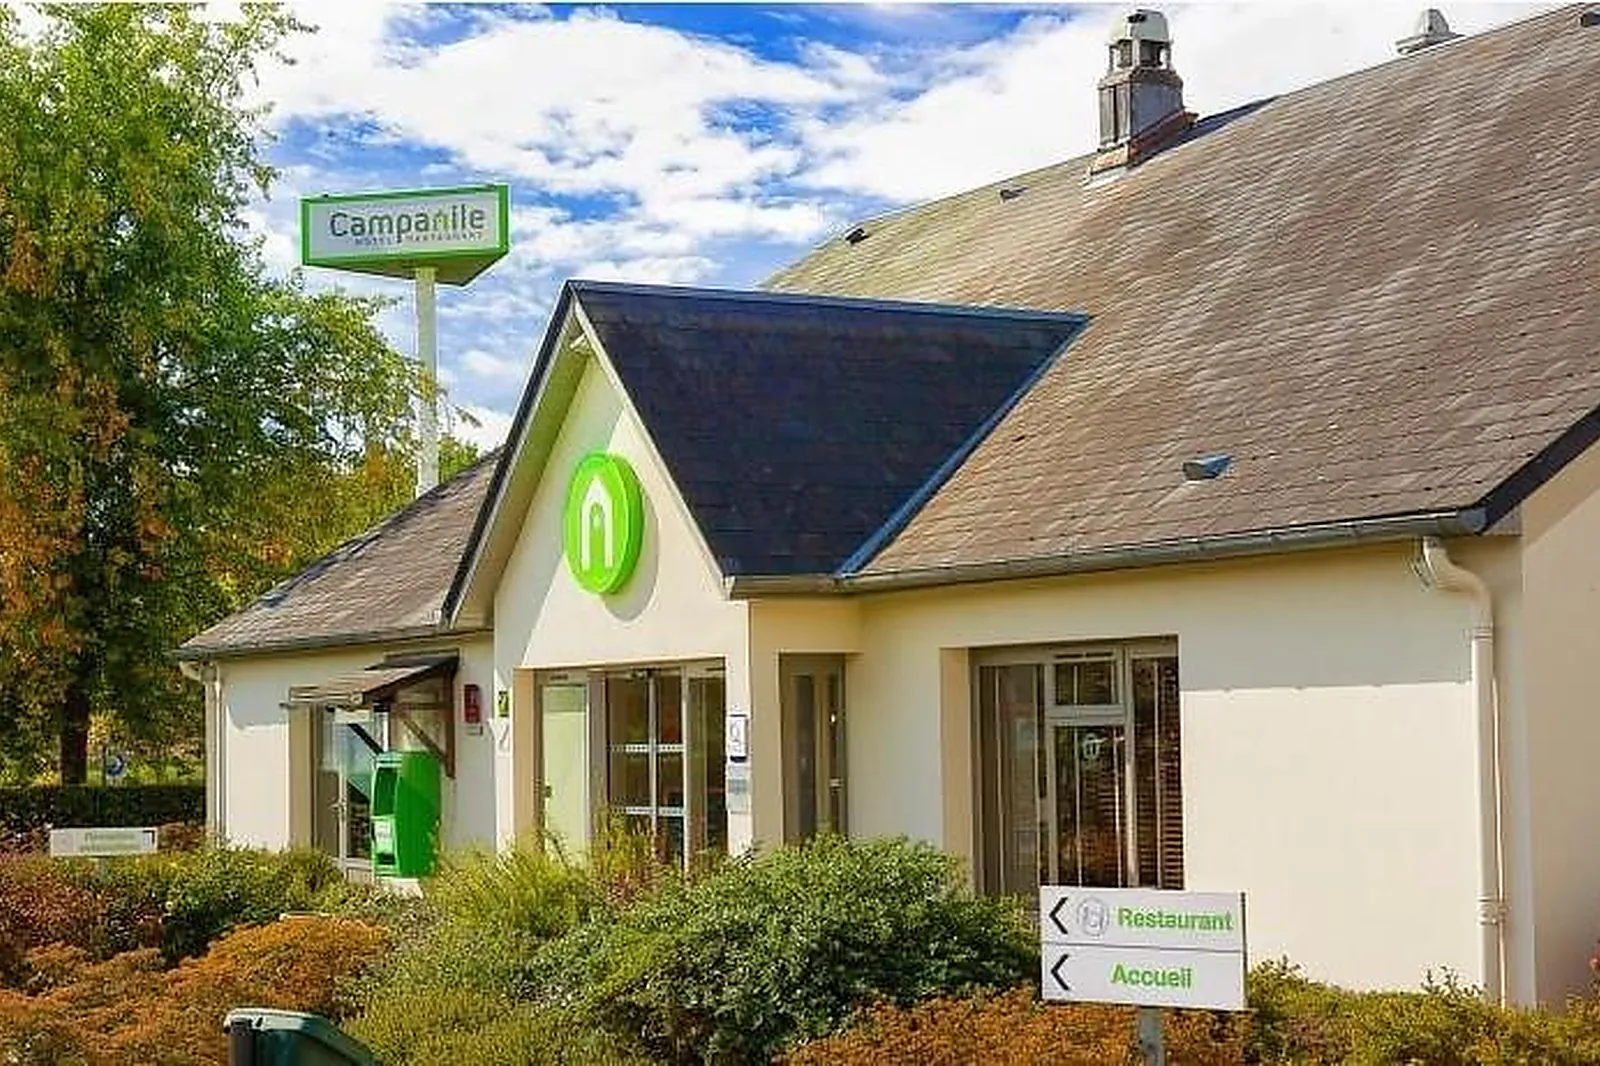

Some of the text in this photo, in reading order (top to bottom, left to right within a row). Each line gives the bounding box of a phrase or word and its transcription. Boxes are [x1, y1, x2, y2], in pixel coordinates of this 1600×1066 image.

[330, 203, 485, 243] Campanile
[1118, 908, 1234, 931] Restaurant
[1112, 964, 1193, 989] Accueil
